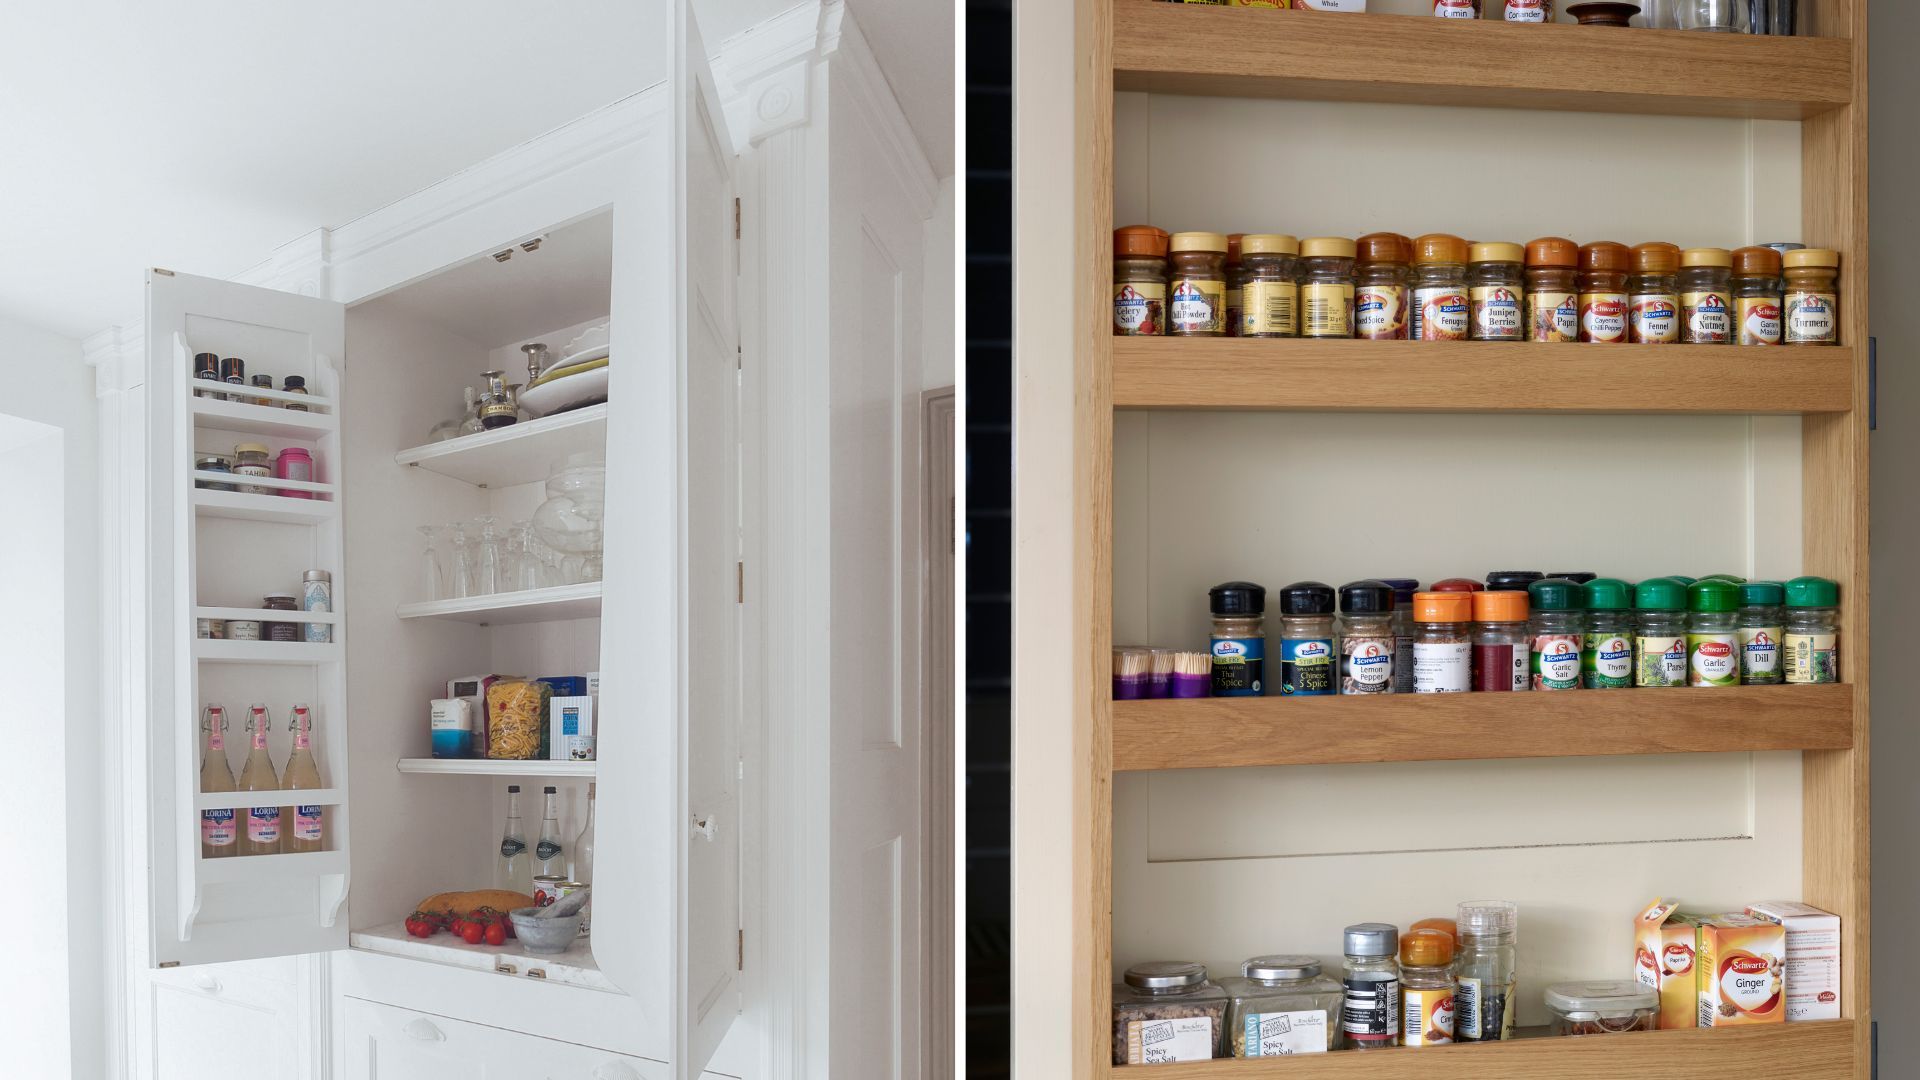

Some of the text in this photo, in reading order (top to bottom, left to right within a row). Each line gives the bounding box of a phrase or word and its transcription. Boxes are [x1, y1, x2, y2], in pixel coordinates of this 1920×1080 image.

[1443, 10, 1467, 18] Cumin
[1116, 307, 1141, 317] Celery
[1591, 304, 1621, 314] Schwartz
[1488, 308, 1515, 320] Juniper
[1644, 310, 1672, 319] SCHWARTZ
[1702, 314, 1722, 322] Ground
[1120, 315, 1135, 323] Salt
[1368, 316, 1384, 325] Spice
[1489, 317, 1516, 326] Berries
[1595, 317, 1618, 326] Cayenne
[1794, 318, 1829, 328] Turmeric
[1604, 324, 1622, 332] Pepper
[1648, 321, 1668, 331] Fennel
[1699, 321, 1725, 331] Nutmeg
[1699, 645, 1730, 654] Schwartz
[1546, 653, 1576, 662] SCHWARTZ
[1603, 650, 1630, 659] SCHWARTZ
[1754, 654, 1769, 663] Dill
[1356, 656, 1387, 665] SCHWARTZ
[1703, 659, 1726, 668] Garlic
[1360, 665, 1383, 673] Lemon
[1551, 663, 1572, 671] Garlic
[1607, 663, 1627, 671] Thyme
[1221, 670, 1235, 678] Thai
[1300, 672, 1326, 680] Chinese
[1360, 673, 1384, 682] Pepper
[1555, 670, 1569, 678] Salt
[1221, 677, 1243, 689] Spice
[1307, 678, 1328, 690] Spice
[205, 809, 232, 817] LORINA
[254, 807, 279, 815] LORINA
[1733, 961, 1766, 971] Schwartz
[1735, 978, 1765, 990] Ginger
[1263, 1040, 1283, 1050] Spicy
[1145, 1047, 1167, 1056] Spicy
